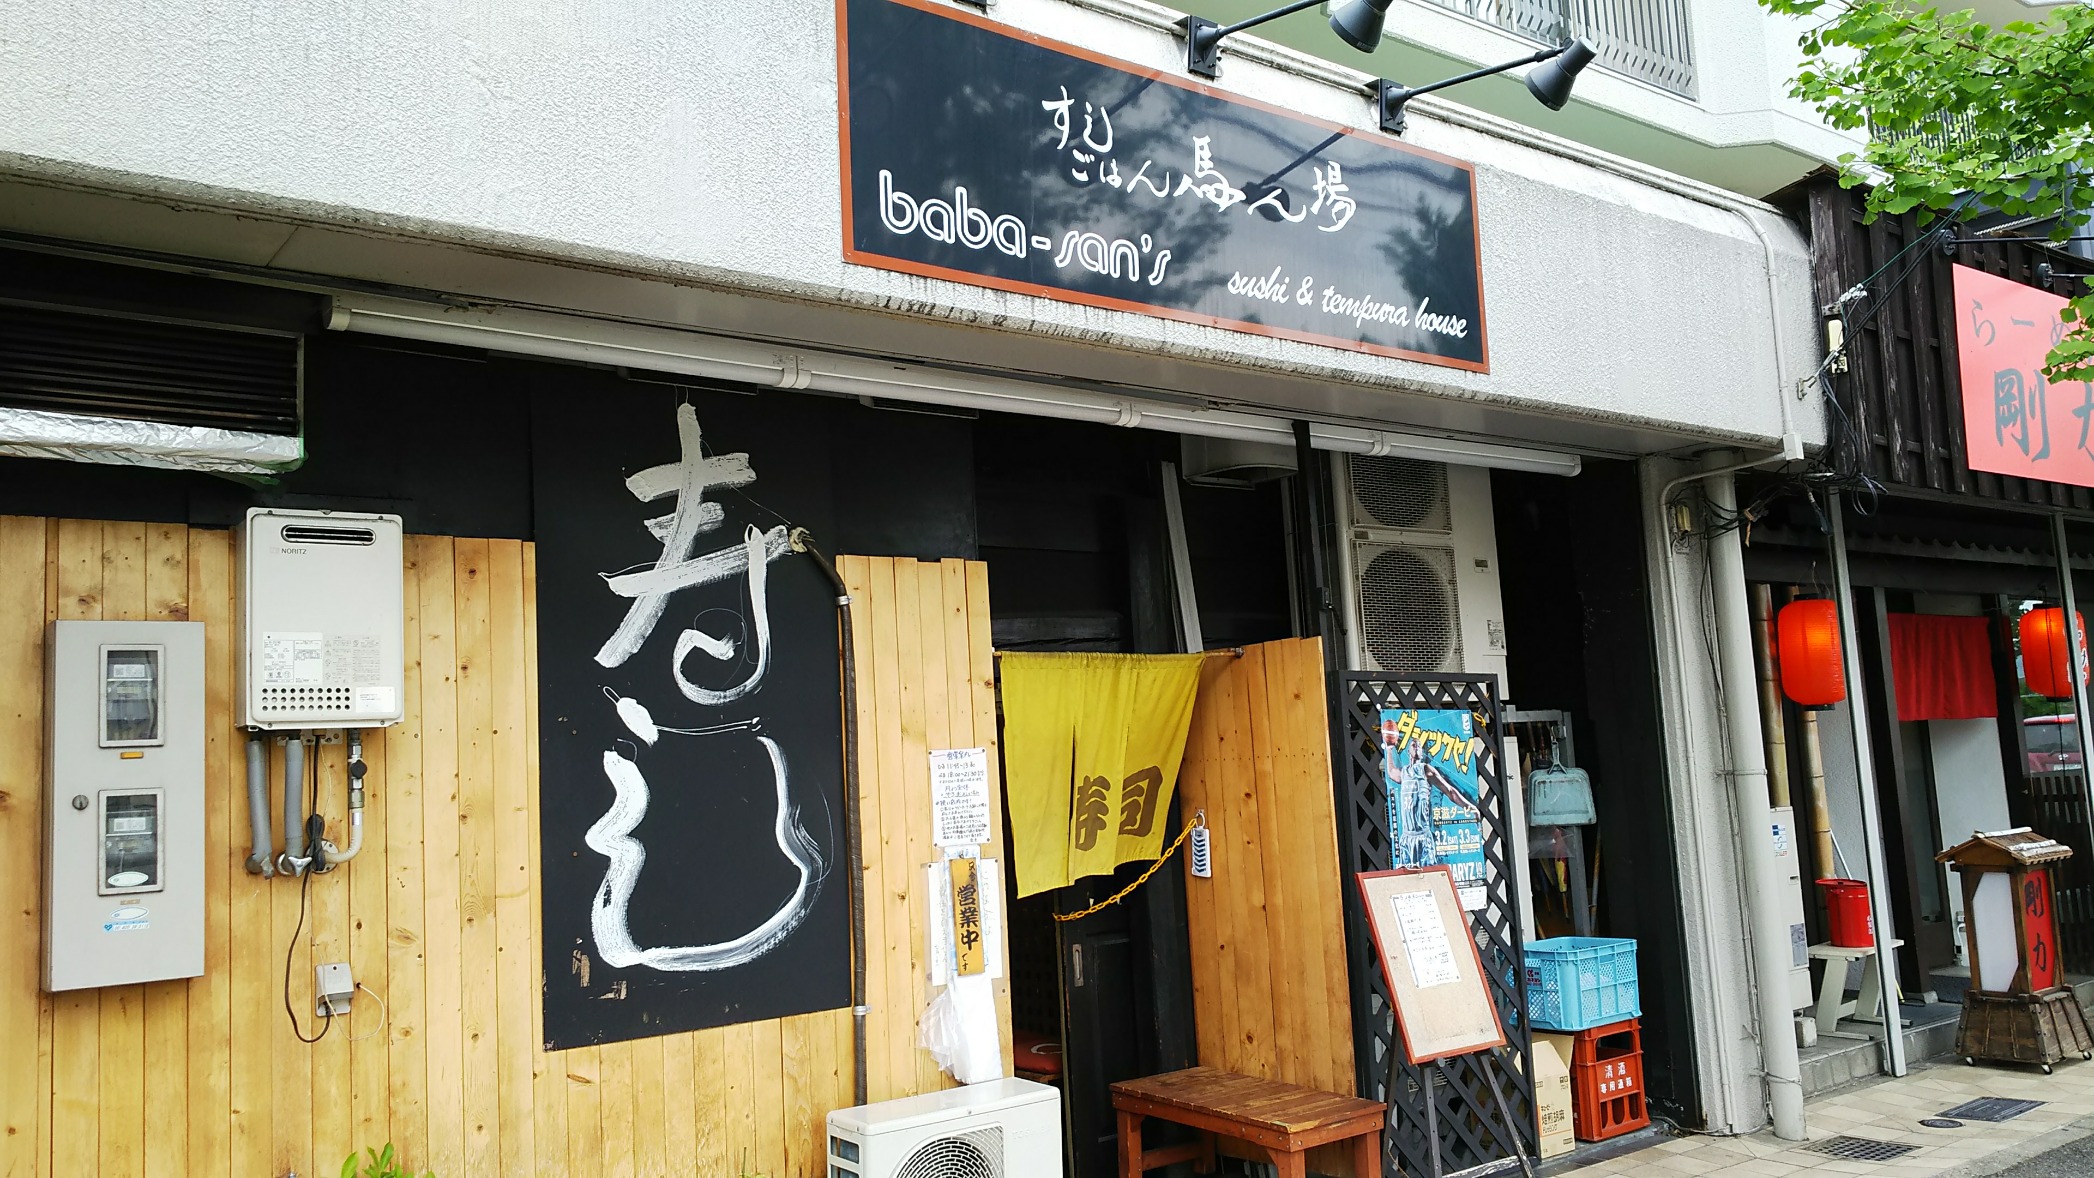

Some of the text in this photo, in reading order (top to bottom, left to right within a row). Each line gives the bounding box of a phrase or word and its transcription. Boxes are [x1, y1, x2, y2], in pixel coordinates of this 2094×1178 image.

[879, 169, 1171, 286] baba-san's
[1228, 265, 1468, 338] sushi & tempura house
[1450, 862, 1476, 881] ARYZ
[957, 884, 979, 951] 営業中
